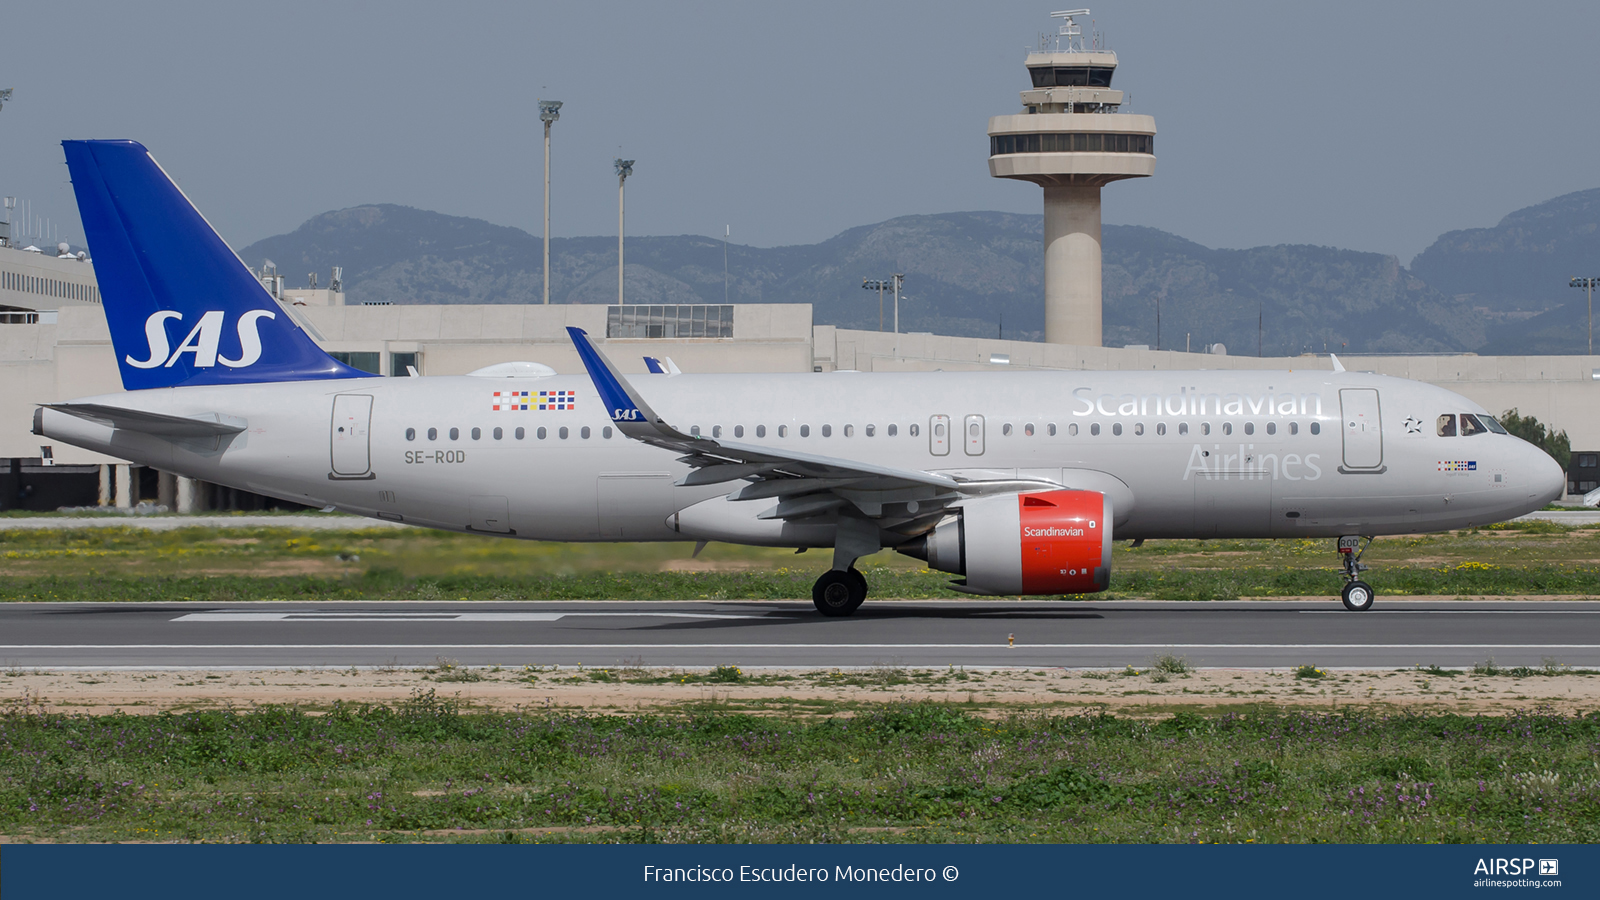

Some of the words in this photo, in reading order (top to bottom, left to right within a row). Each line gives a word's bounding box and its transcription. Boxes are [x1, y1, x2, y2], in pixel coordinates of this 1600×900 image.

[125, 309, 276, 369] SAS
[1071, 386, 1322, 416] Scandinavian
[611, 408, 639, 421] SAS
[404, 450, 466, 464] SE-ROD
[1182, 443, 1322, 481] Airlines
[1024, 526, 1084, 537] Scandinavian
[1340, 539, 1358, 547] ROD
